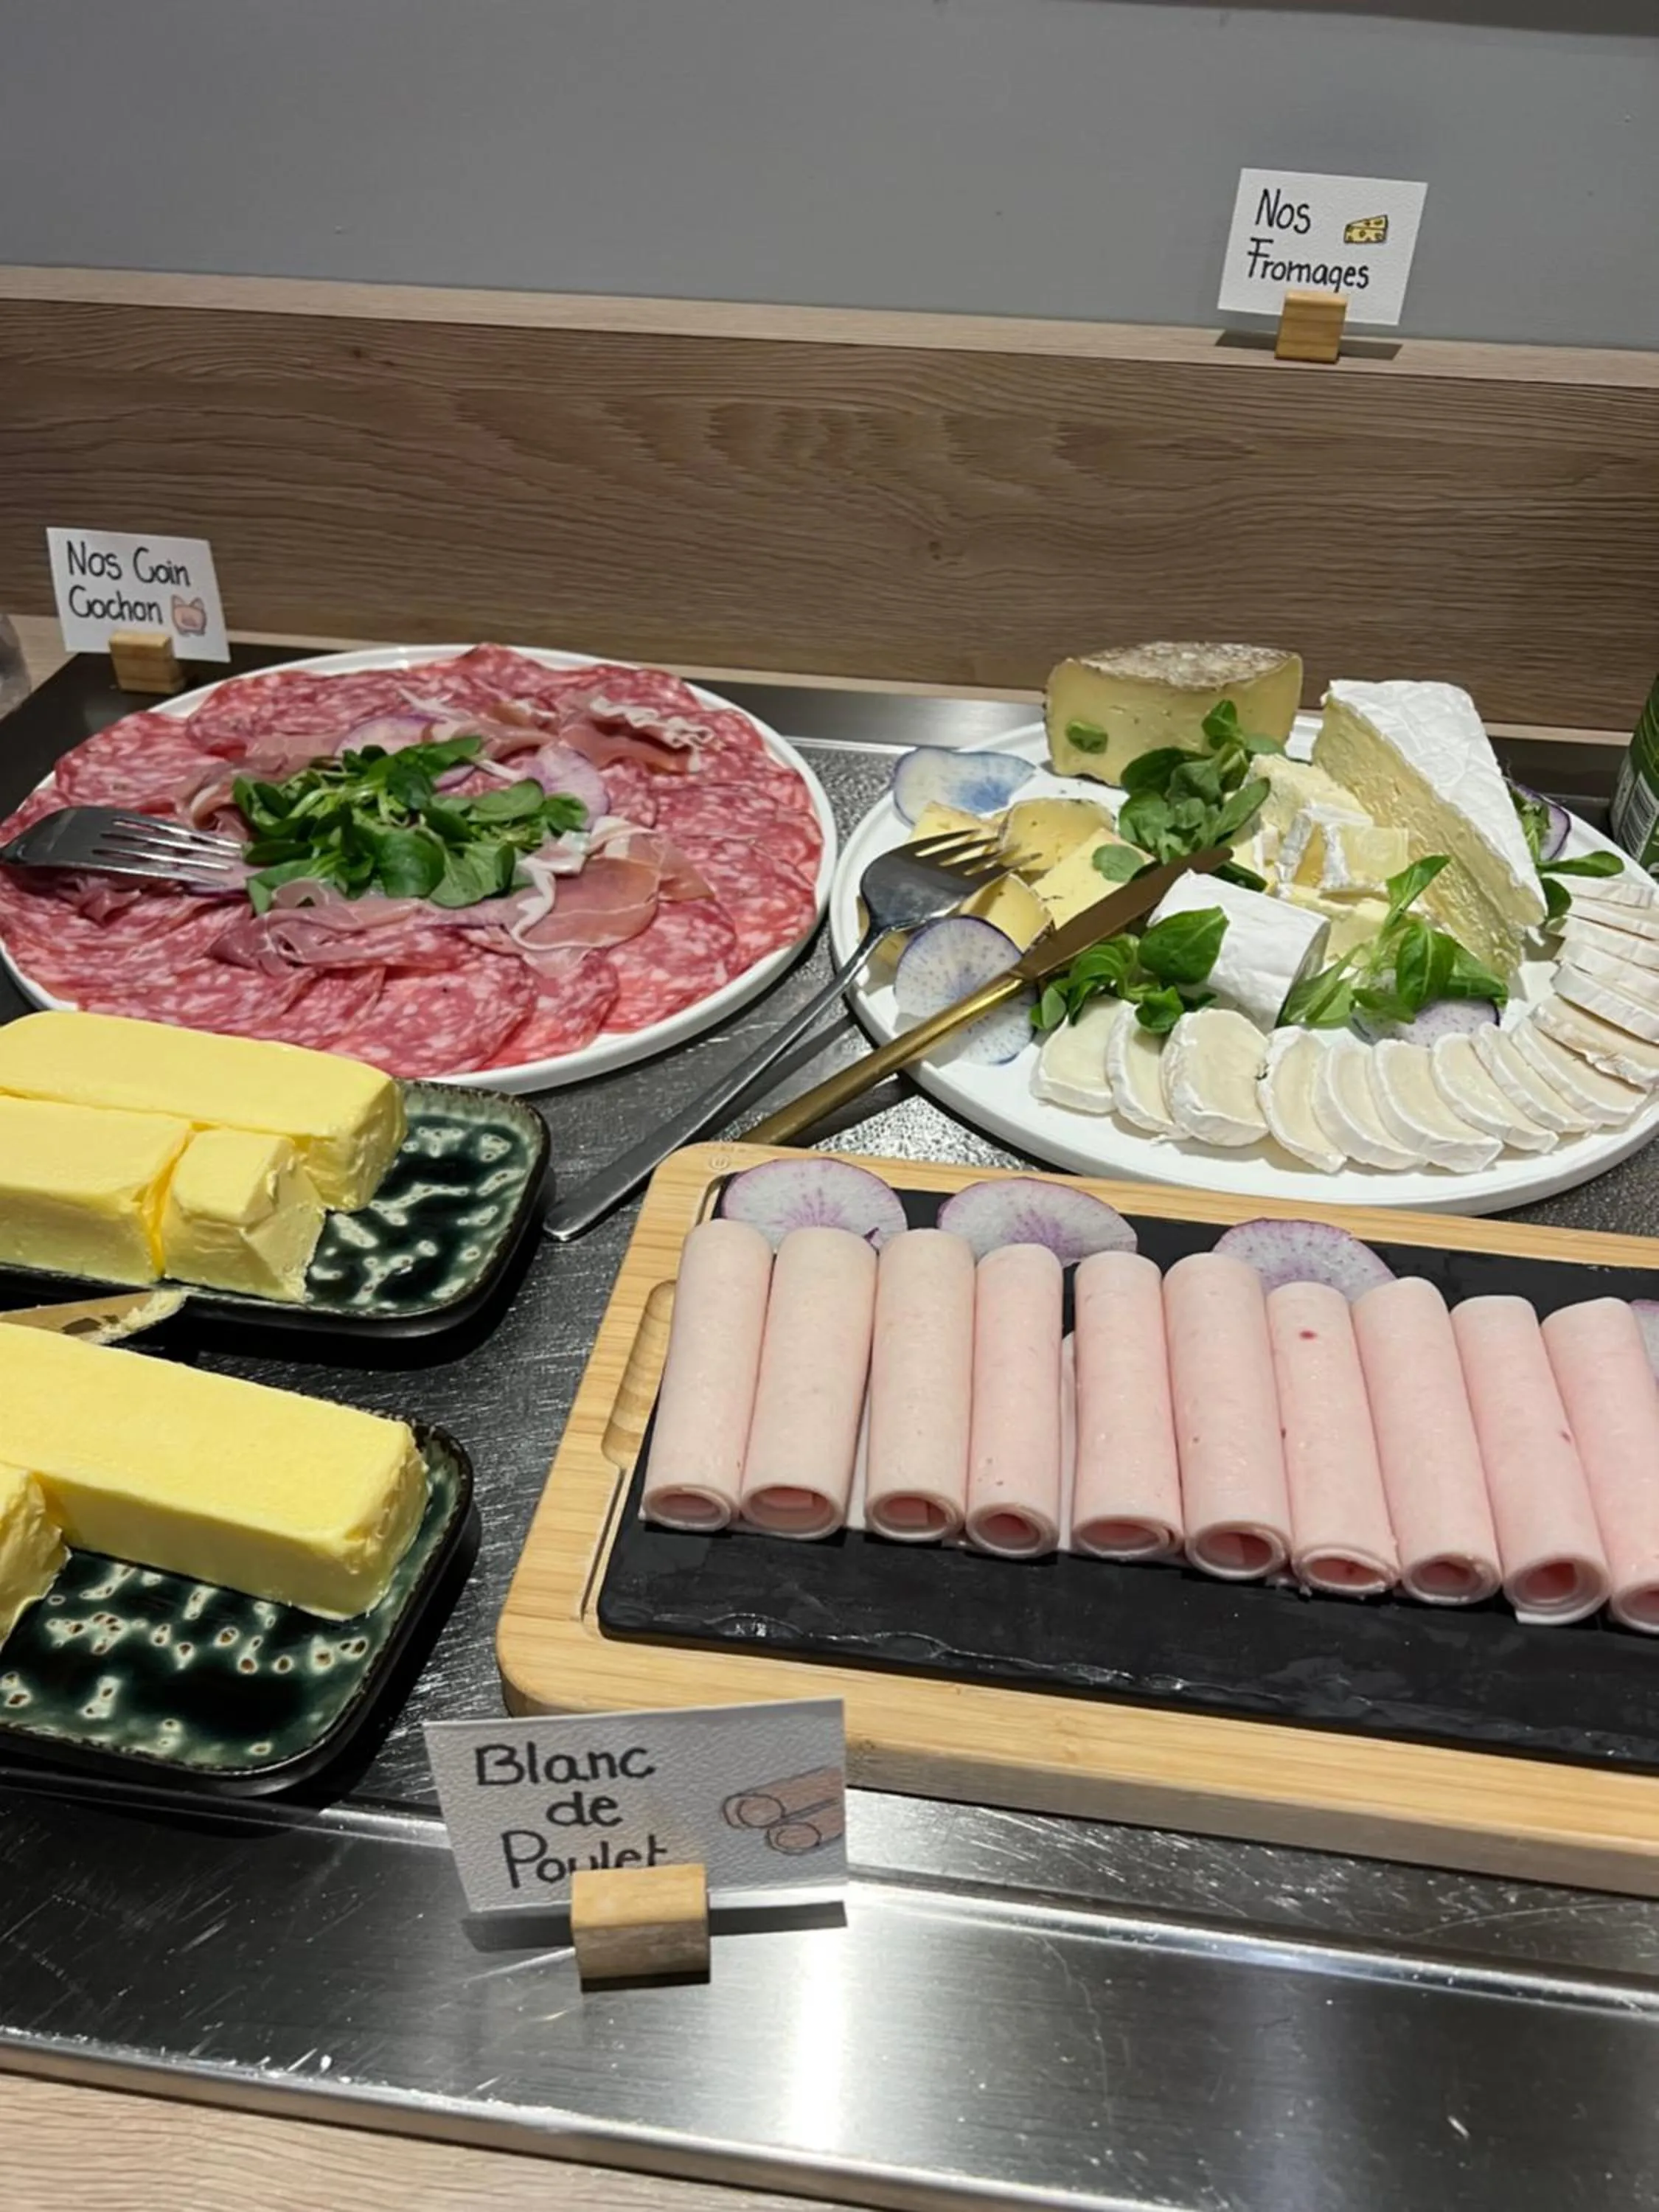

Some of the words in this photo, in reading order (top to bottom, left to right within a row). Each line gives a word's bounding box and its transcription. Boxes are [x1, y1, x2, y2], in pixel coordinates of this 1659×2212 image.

[1255, 188, 1312, 234] Nos
[1248, 237, 1370, 293] Fromages
[66, 540, 122, 581] Nos
[133, 546, 191, 588] Coin
[69, 585, 164, 625] Cochon
[475, 1741, 656, 1786] Blanc
[546, 1792, 622, 1827] de
